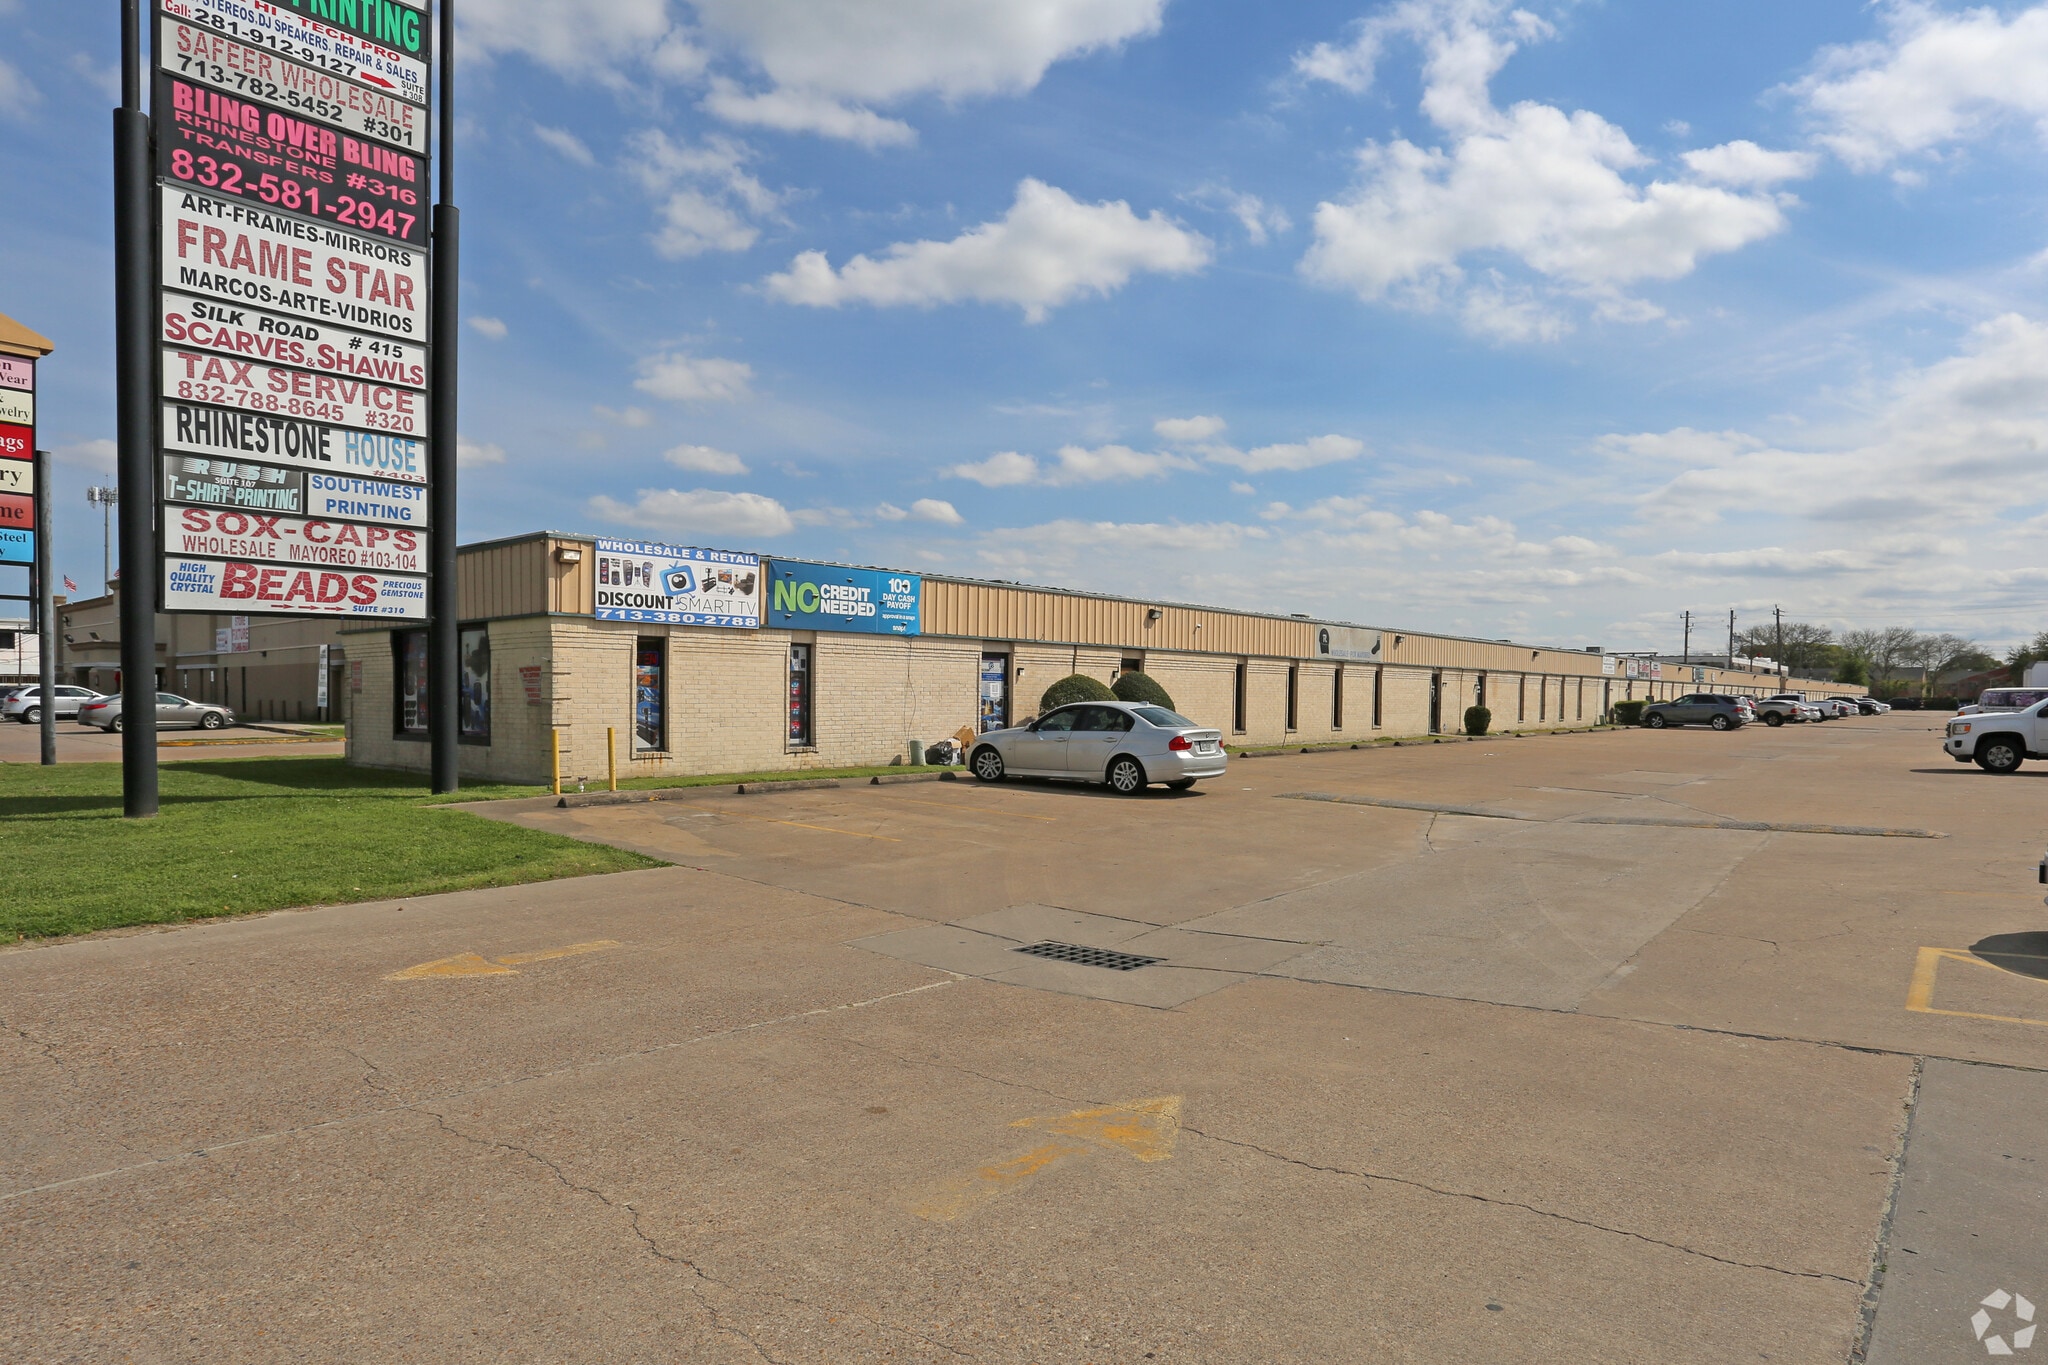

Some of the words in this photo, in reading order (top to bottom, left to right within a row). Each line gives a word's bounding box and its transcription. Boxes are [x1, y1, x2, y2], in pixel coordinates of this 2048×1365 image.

[165, 0, 191, 18] Call:
[194, 8, 357, 76] 281-912-9127
[254, 0, 277, 16] HI
[298, 16, 353, 45] TECH
[361, 41, 401, 62] PRO
[292, 0, 420, 52] INTING
[177, 25, 273, 81] SAFEER
[281, 60, 414, 129] WHOLESALE
[335, 42, 372, 67] REPAIR
[376, 58, 383, 71] &
[386, 62, 418, 84] SALES
[177, 53, 343, 122] 713-782-5452
[363, 116, 413, 146] #301
[400, 80, 425, 95] SUITE
[172, 80, 261, 135] BLING
[267, 112, 337, 158] OVER
[343, 135, 416, 182] BLING
[174, 110, 337, 169] RHINESTONE
[178, 127, 334, 184] TRANSFERS
[346, 172, 417, 206] #316
[171, 148, 416, 239] 832-581-2947
[180, 193, 412, 267] ART-FRAMES-MIRRORS
[177, 218, 313, 287] FRAME
[325, 256, 415, 311] STAR
[180, 266, 413, 333] MARCOS-ARTE-VIDRIOS
[191, 301, 245, 326] SILK
[258, 316, 320, 341] ROAD
[0, 362, 12, 371] n
[165, 312, 305, 364] SCARVES
[306, 355, 316, 368] &
[317, 343, 424, 386] SHAWLS
[177, 351, 254, 389] TAX
[267, 367, 415, 415] SERVICE
[177, 380, 344, 422] 832-788-8645
[365, 410, 414, 433] #320
[176, 405, 332, 462] RHINESTONE
[345, 430, 417, 473] HOUSE
[182, 457, 287, 484] RUSH
[214, 477, 239, 486] SUITE
[241, 480, 256, 488] 107
[311, 474, 423, 500] SOUTHWEST
[168, 474, 231, 504] T-SHIRT
[234, 487, 298, 511] PRINTING
[325, 498, 412, 521] PRINTING
[180, 508, 418, 552] SOX-CAPS
[179, 562, 207, 574] HIGH
[182, 534, 276, 559] WHOLESALE
[289, 543, 356, 566] MAYOREO
[360, 549, 417, 570] #103-104
[598, 540, 691, 559] WHOLESALE
[695, 551, 705, 560] &
[710, 552, 758, 565] RETAIL
[170, 571, 215, 584] QUALITY
[170, 581, 214, 594] CRYSTAL
[219, 562, 379, 605] BEADS
[380, 588, 424, 600] GEMSTONE
[382, 580, 423, 590] PRECIOUS
[888, 578, 911, 594] 100
[352, 604, 378, 613] SUITE
[381, 606, 405, 614] #310
[598, 591, 674, 610] DISCOUNT
[678, 596, 734, 614] SMART
[738, 601, 757, 615] TV
[774, 579, 820, 613] NO
[820, 584, 870, 602] CREDIT
[820, 599, 876, 617] NEEDED
[882, 593, 897, 601] DAY
[897, 594, 915, 603] CASH
[886, 600, 912, 610] PAYOFF
[597, 609, 758, 627] 713-380-2788
